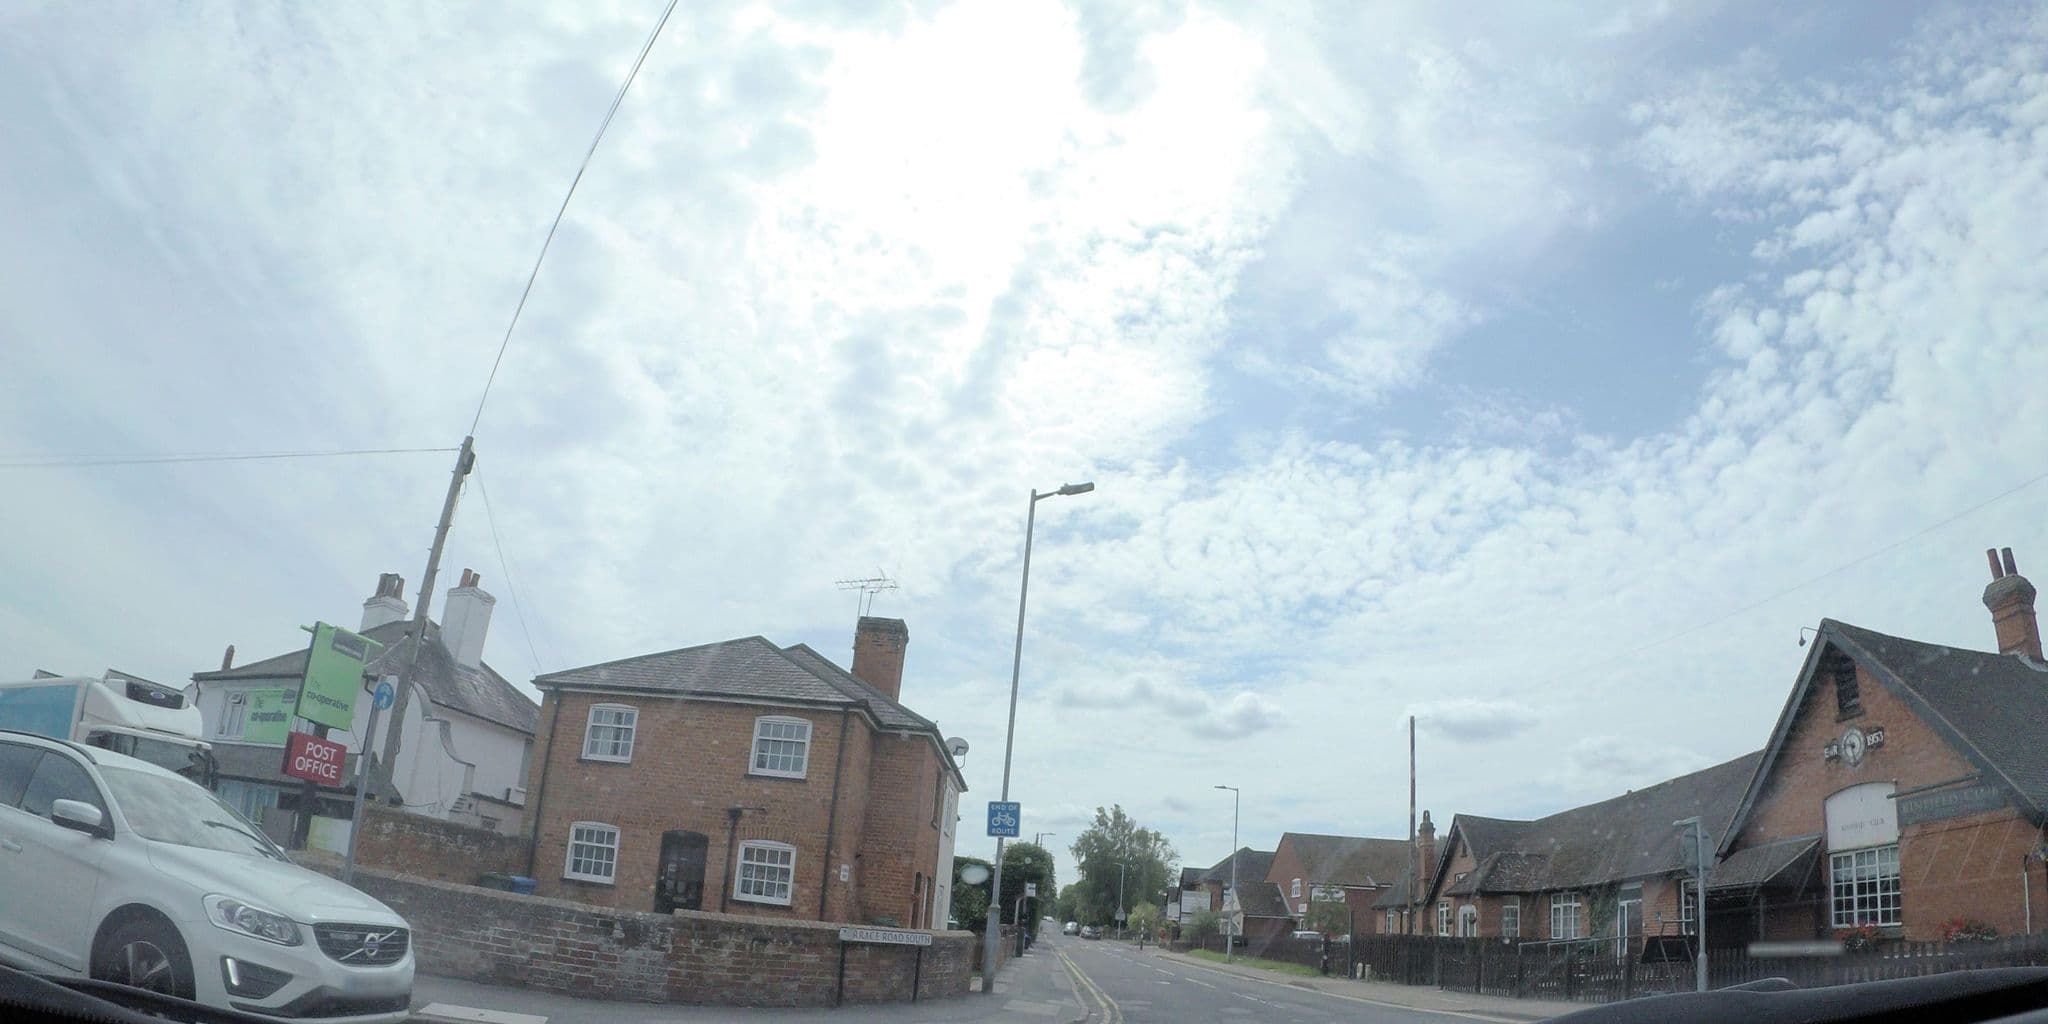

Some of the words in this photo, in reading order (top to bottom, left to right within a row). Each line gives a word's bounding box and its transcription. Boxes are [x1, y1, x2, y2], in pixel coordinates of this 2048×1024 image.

[307, 691, 351, 712] co-operative
[1866, 731, 1884, 746] 1953
[306, 742, 338, 760] POST
[295, 756, 338, 779] OFFICE
[842, 929, 880, 940] TRRACE
[882, 932, 905, 942] ROAD
[905, 934, 930, 944] SOUTH
